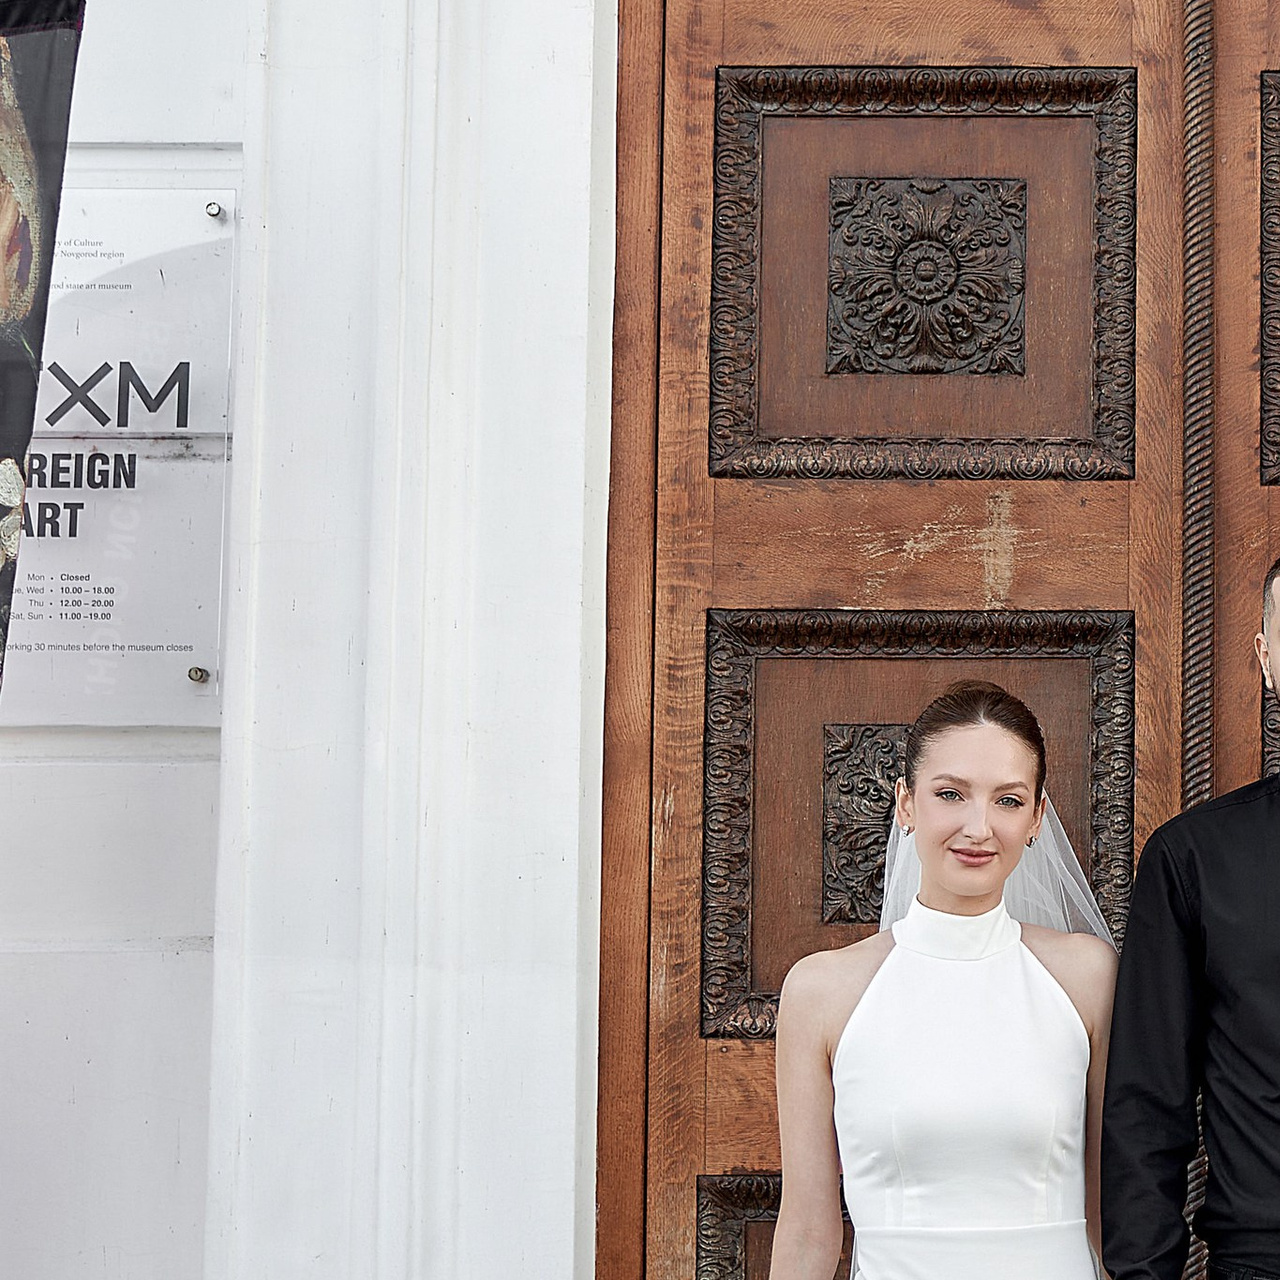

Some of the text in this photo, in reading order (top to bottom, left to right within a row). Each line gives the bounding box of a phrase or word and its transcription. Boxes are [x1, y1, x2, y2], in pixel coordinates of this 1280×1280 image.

[64, 239, 72, 247] of
[73, 239, 104, 247] Culture
[61, 250, 98, 260] Novgorod
[100, 251, 125, 259] region
[66, 282, 84, 290] state
[85, 282, 97, 290] art
[40, 361, 191, 428] ХМ
[27, 453, 137, 490] REIGN
[27, 573, 91, 581] Mon Closed
[26, 586, 45, 594] Wed
[60, 586, 83, 594] 10.00
[92, 586, 115, 594] 18.00
[29, 599, 44, 607] Thu
[60, 599, 82, 607] 12.00
[91, 599, 115, 607] 20.00
[27, 612, 44, 620] Sun
[59, 612, 82, 620] 11.00
[6, 642, 194, 653] orking 30 minutes before the museum closes
